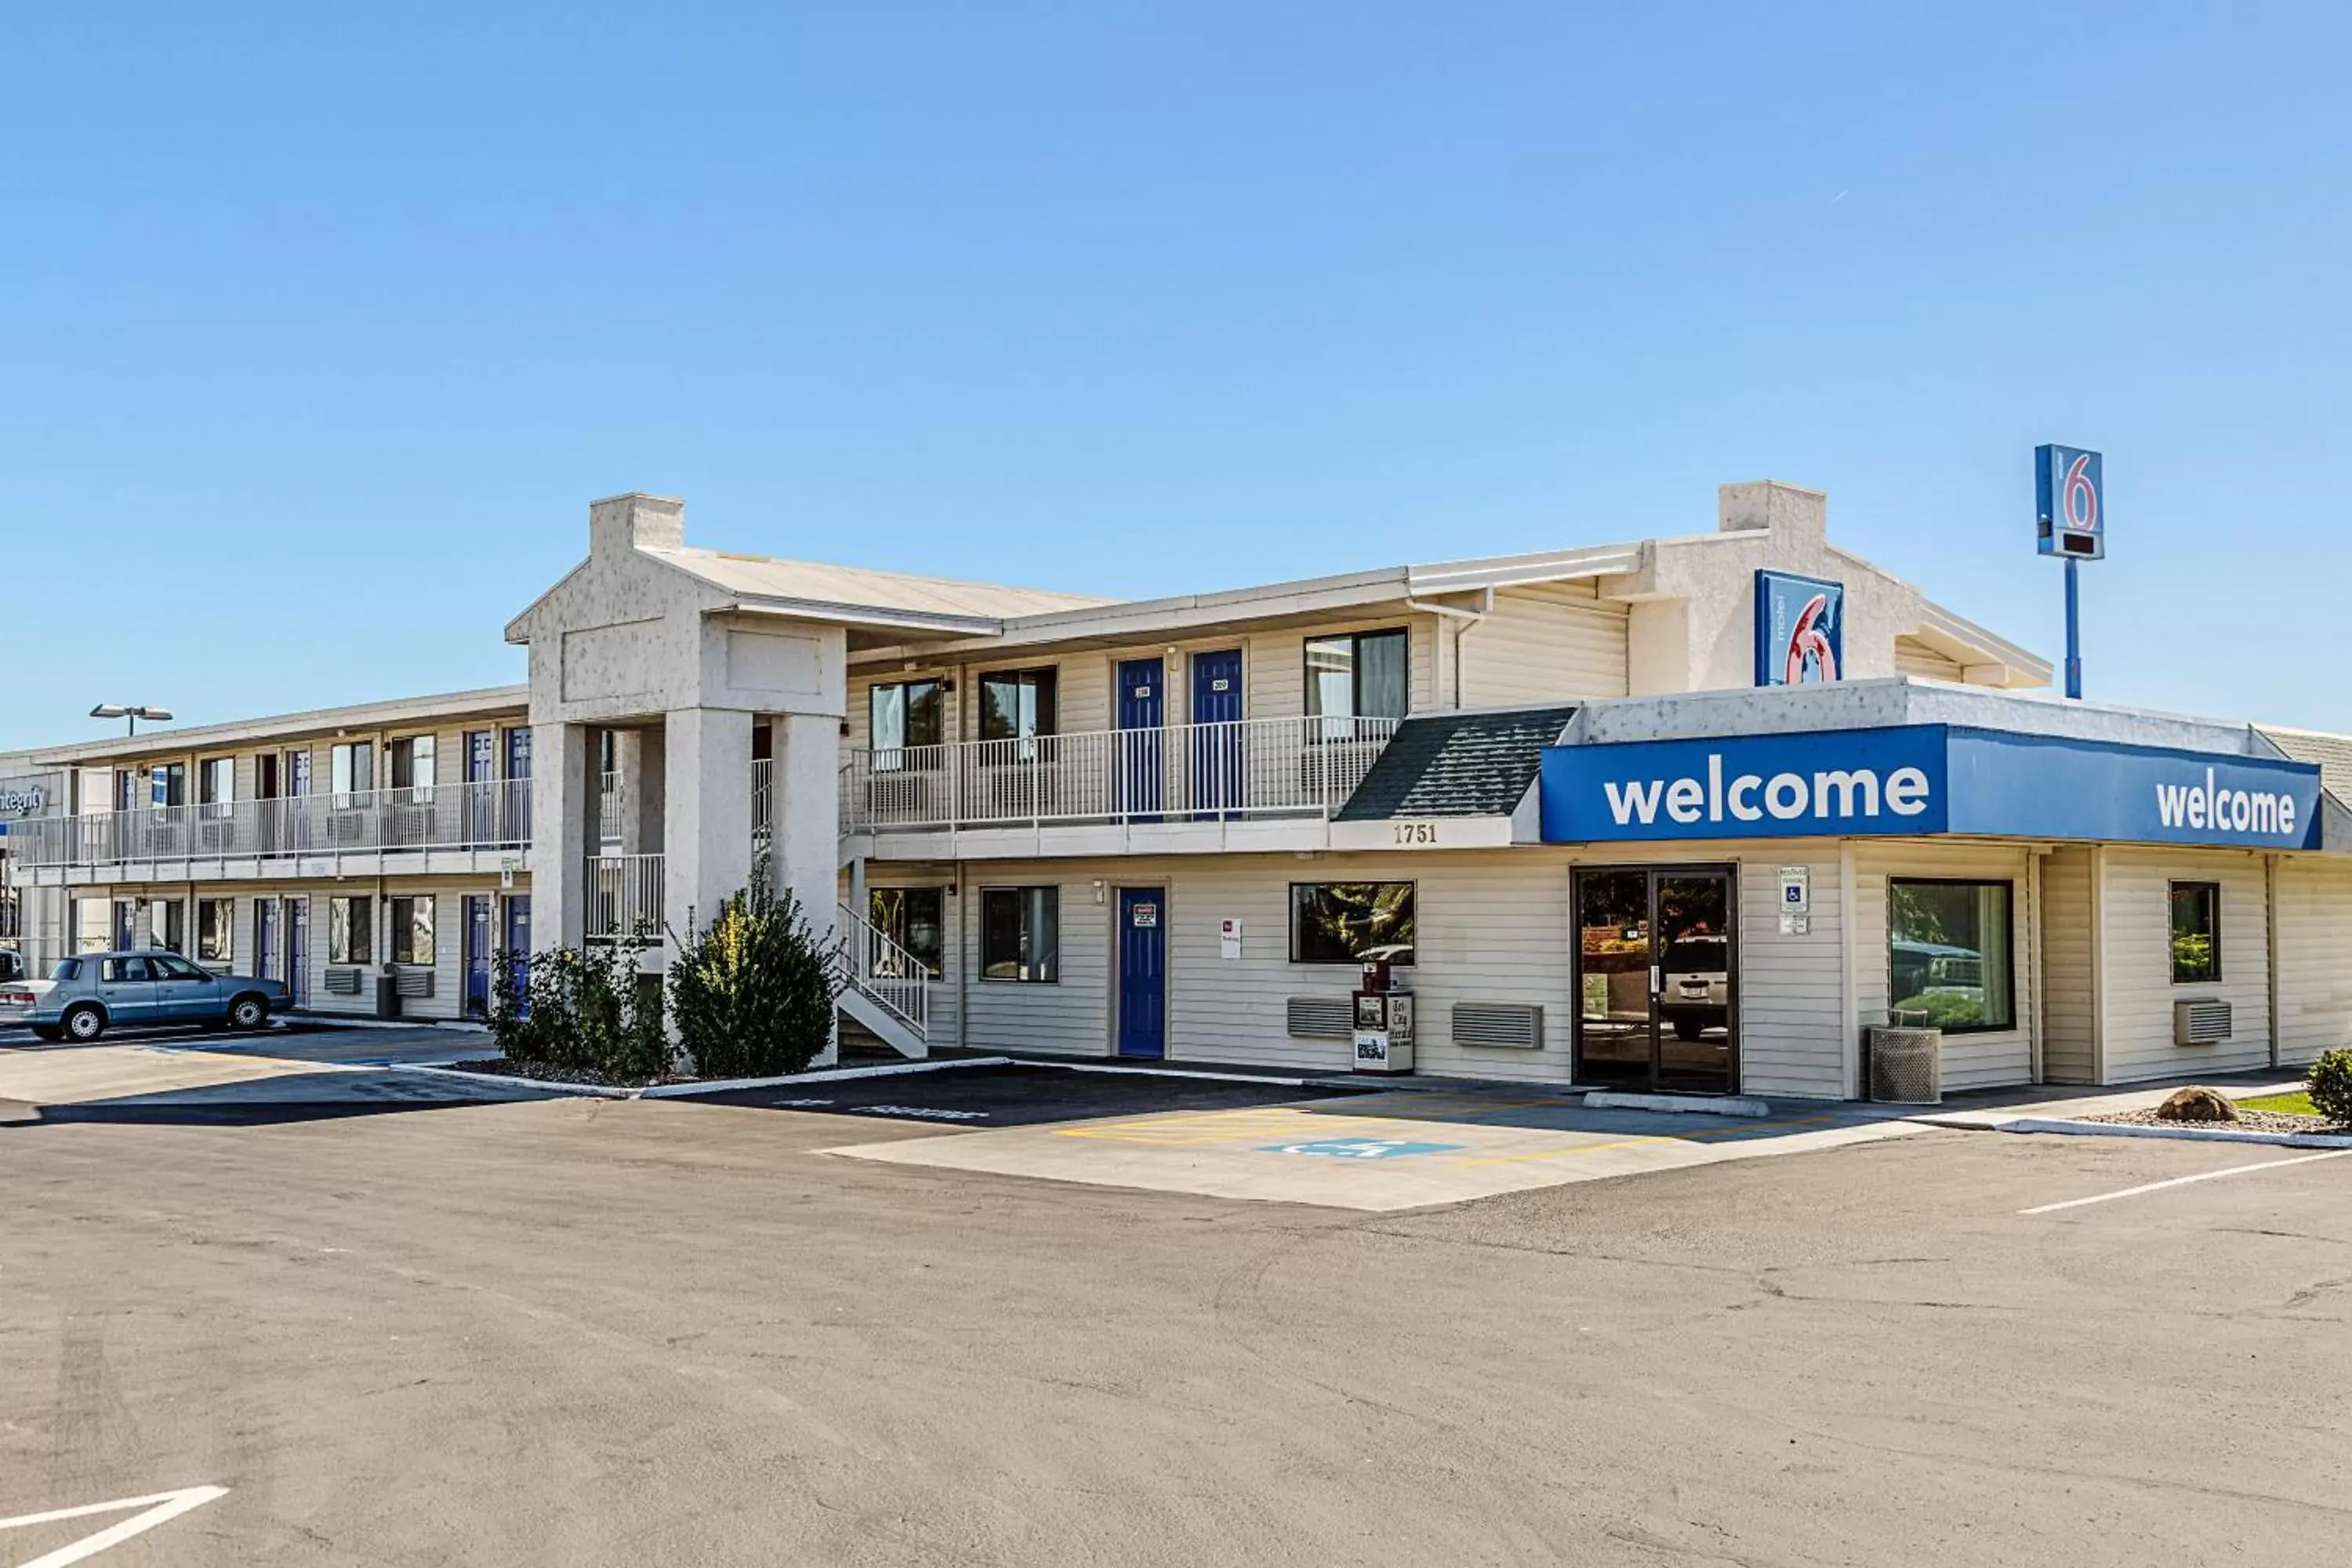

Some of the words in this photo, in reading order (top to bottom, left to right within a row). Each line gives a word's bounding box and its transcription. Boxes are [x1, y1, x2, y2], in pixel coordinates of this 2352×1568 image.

[2063, 454, 2096, 531] 6
[1776, 595, 1785, 641] motel
[1604, 753, 1929, 826] welcome
[2156, 767, 2296, 834] welcome
[1394, 824, 1437, 844] 1751
